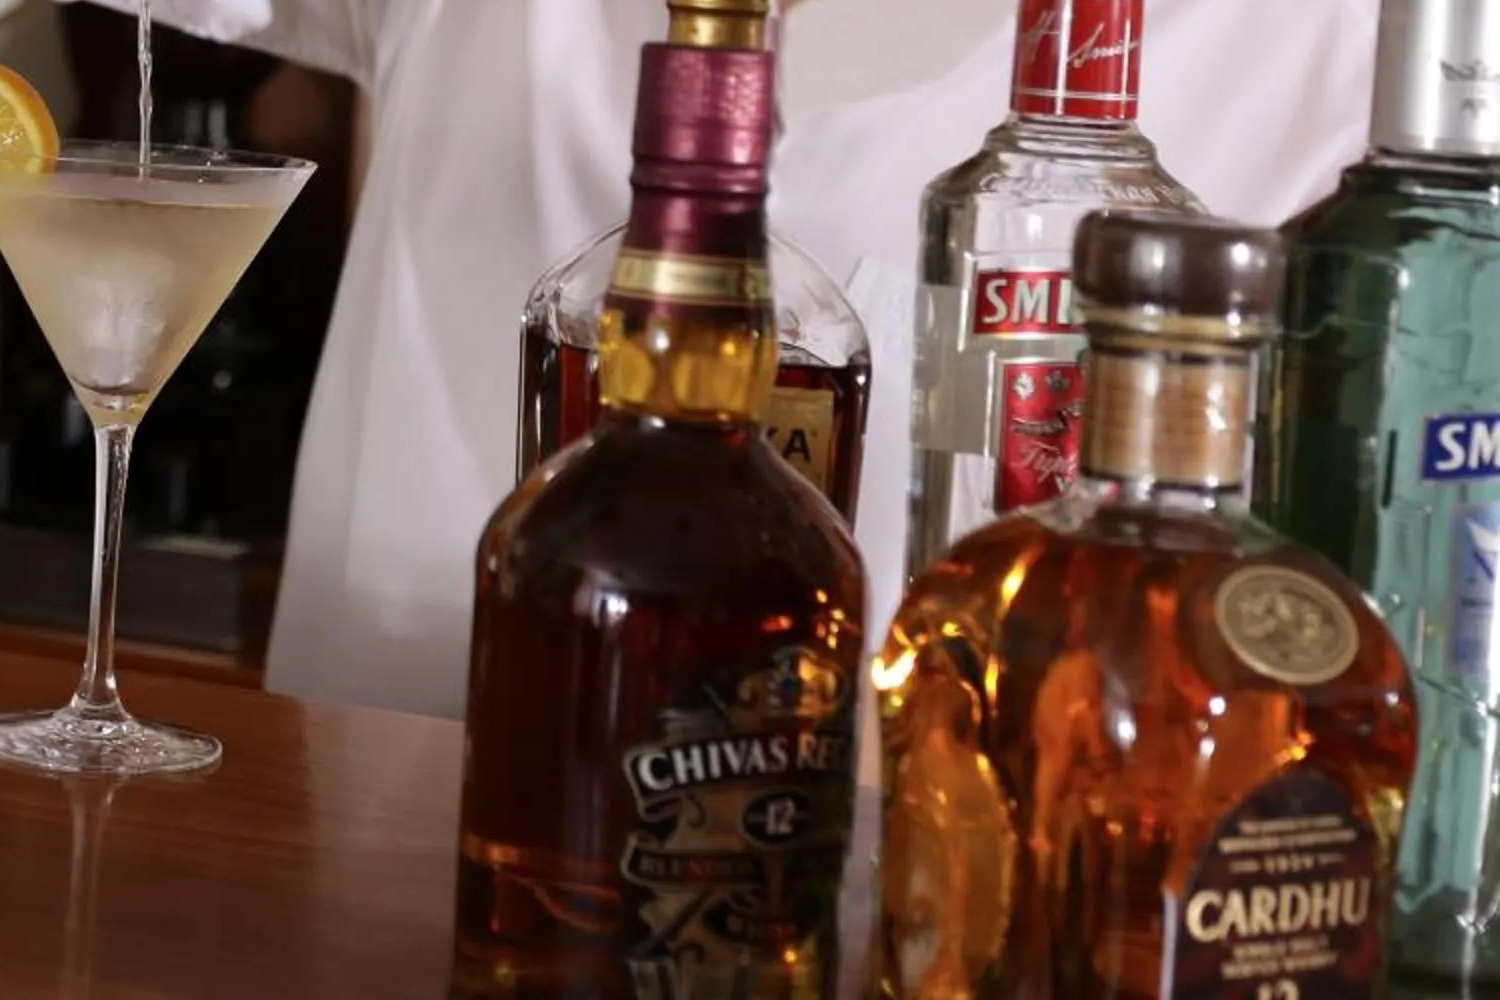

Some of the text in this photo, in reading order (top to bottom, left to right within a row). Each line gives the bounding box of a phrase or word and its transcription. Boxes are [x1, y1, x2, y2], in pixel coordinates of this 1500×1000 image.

[1434, 421, 1500, 471] SM
[637, 735, 790, 792] CHIVAS
[765, 797, 797, 835] 12
[1185, 878, 1370, 942] CARDHU
